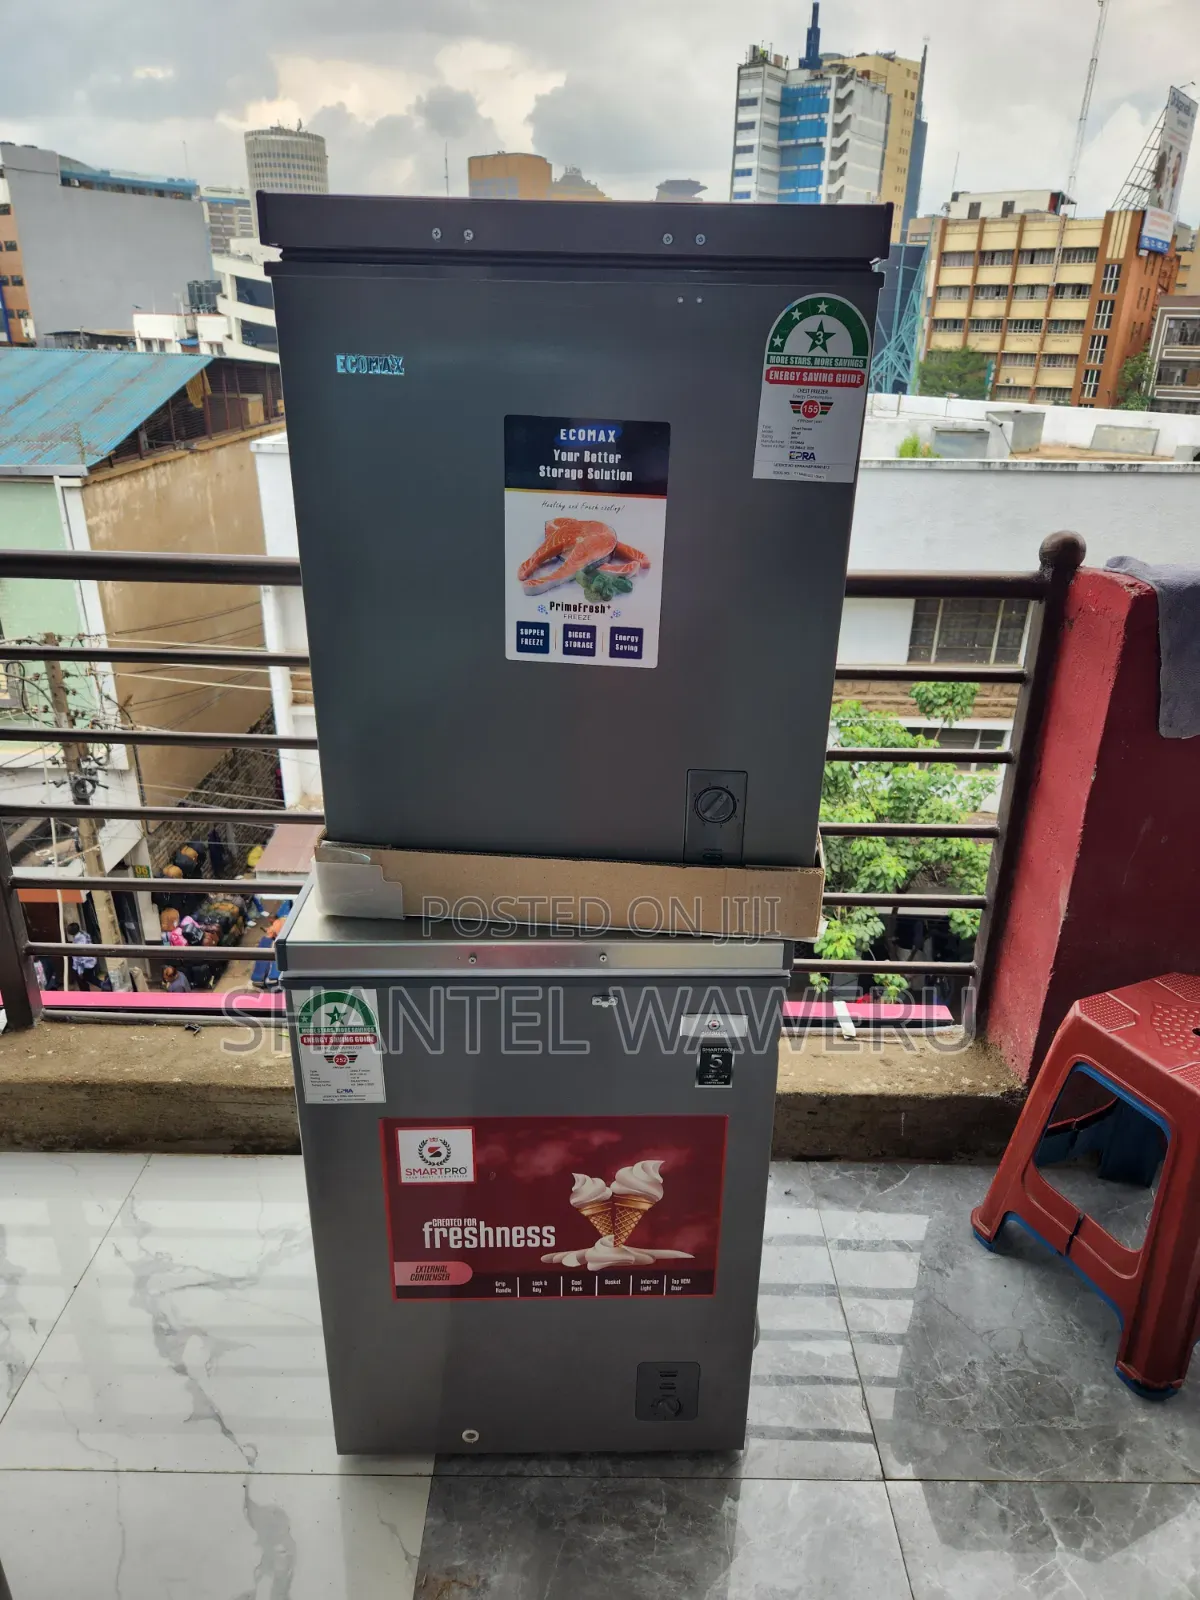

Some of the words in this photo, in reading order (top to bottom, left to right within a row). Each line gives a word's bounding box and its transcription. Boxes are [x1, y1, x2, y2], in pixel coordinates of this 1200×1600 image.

[814, 331, 824, 345] 3
[336, 354, 404, 375] ECOMAX
[769, 355, 789, 365] MORE
[789, 356, 813, 366] STARS,
[814, 357, 833, 367] MORE
[834, 358, 864, 368] SAVINGS
[769, 370, 800, 381] ENERGY
[802, 372, 834, 383] SAVING
[835, 374, 861, 384] GUIDE
[803, 405, 819, 414] 155
[560, 428, 616, 443] ECOMAX
[553, 449, 580, 462] Your
[584, 451, 622, 464] Better
[539, 465, 583, 480] Storage
[587, 468, 633, 482] Solution
[520, 628, 545, 637] SUPPER
[568, 631, 591, 639] BIGGER
[520, 638, 544, 646] FREEZE
[615, 634, 639, 643] Energy
[564, 641, 594, 649] STORAGE
[615, 644, 638, 652] Saving
[709, 1054, 723, 1068] 5
[405, 1166, 467, 1176] SMARTPRO
[432, 1218, 463, 1227] CREATED
[463, 1218, 477, 1226] FOR
[422, 1220, 556, 1248] freshness
[416, 1265, 448, 1273] EXTERNAL
[410, 1273, 451, 1281] CONDENSER
